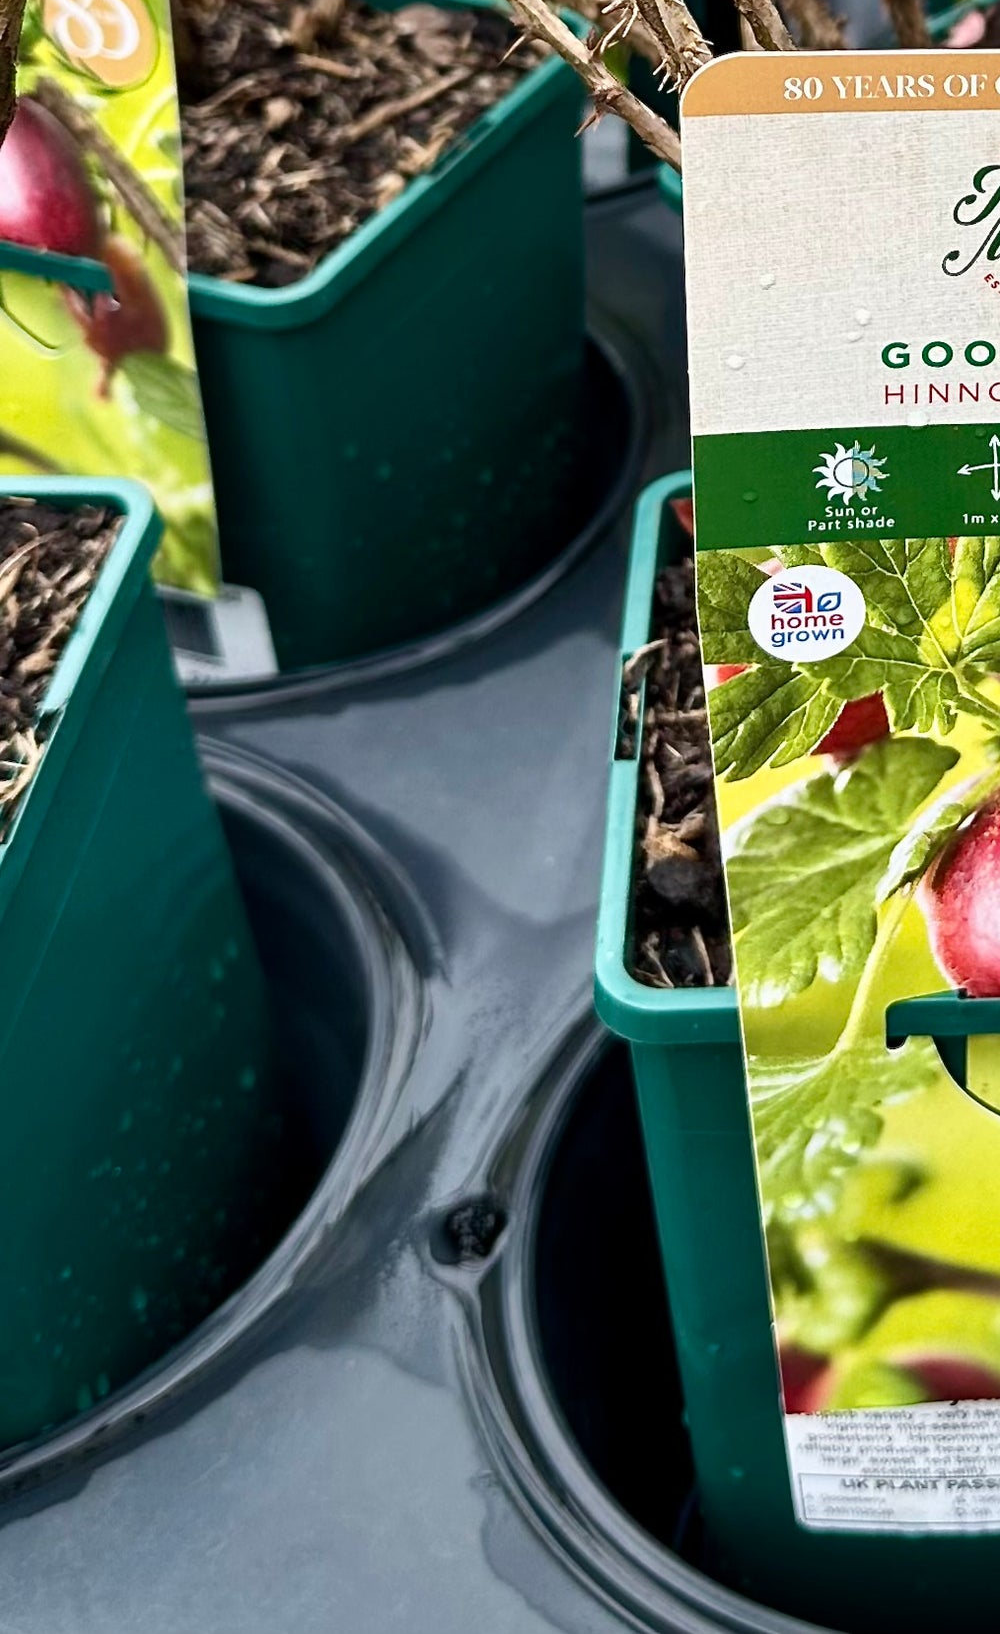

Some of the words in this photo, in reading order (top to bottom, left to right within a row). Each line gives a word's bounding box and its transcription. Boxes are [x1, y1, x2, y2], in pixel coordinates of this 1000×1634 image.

[783, 76, 824, 101] 80
[831, 74, 935, 99] YEARS
[943, 73, 988, 98] OF
[824, 506, 855, 517] Sun
[861, 506, 878, 517] or
[962, 513, 985, 524] 1m
[990, 514, 999, 524] x
[807, 519, 841, 531] Part
[847, 516, 896, 530] shade
[771, 613, 844, 630] home
[771, 628, 845, 647] grown
[840, 1477, 869, 1489] UK
[875, 1477, 940, 1490] PLANT
